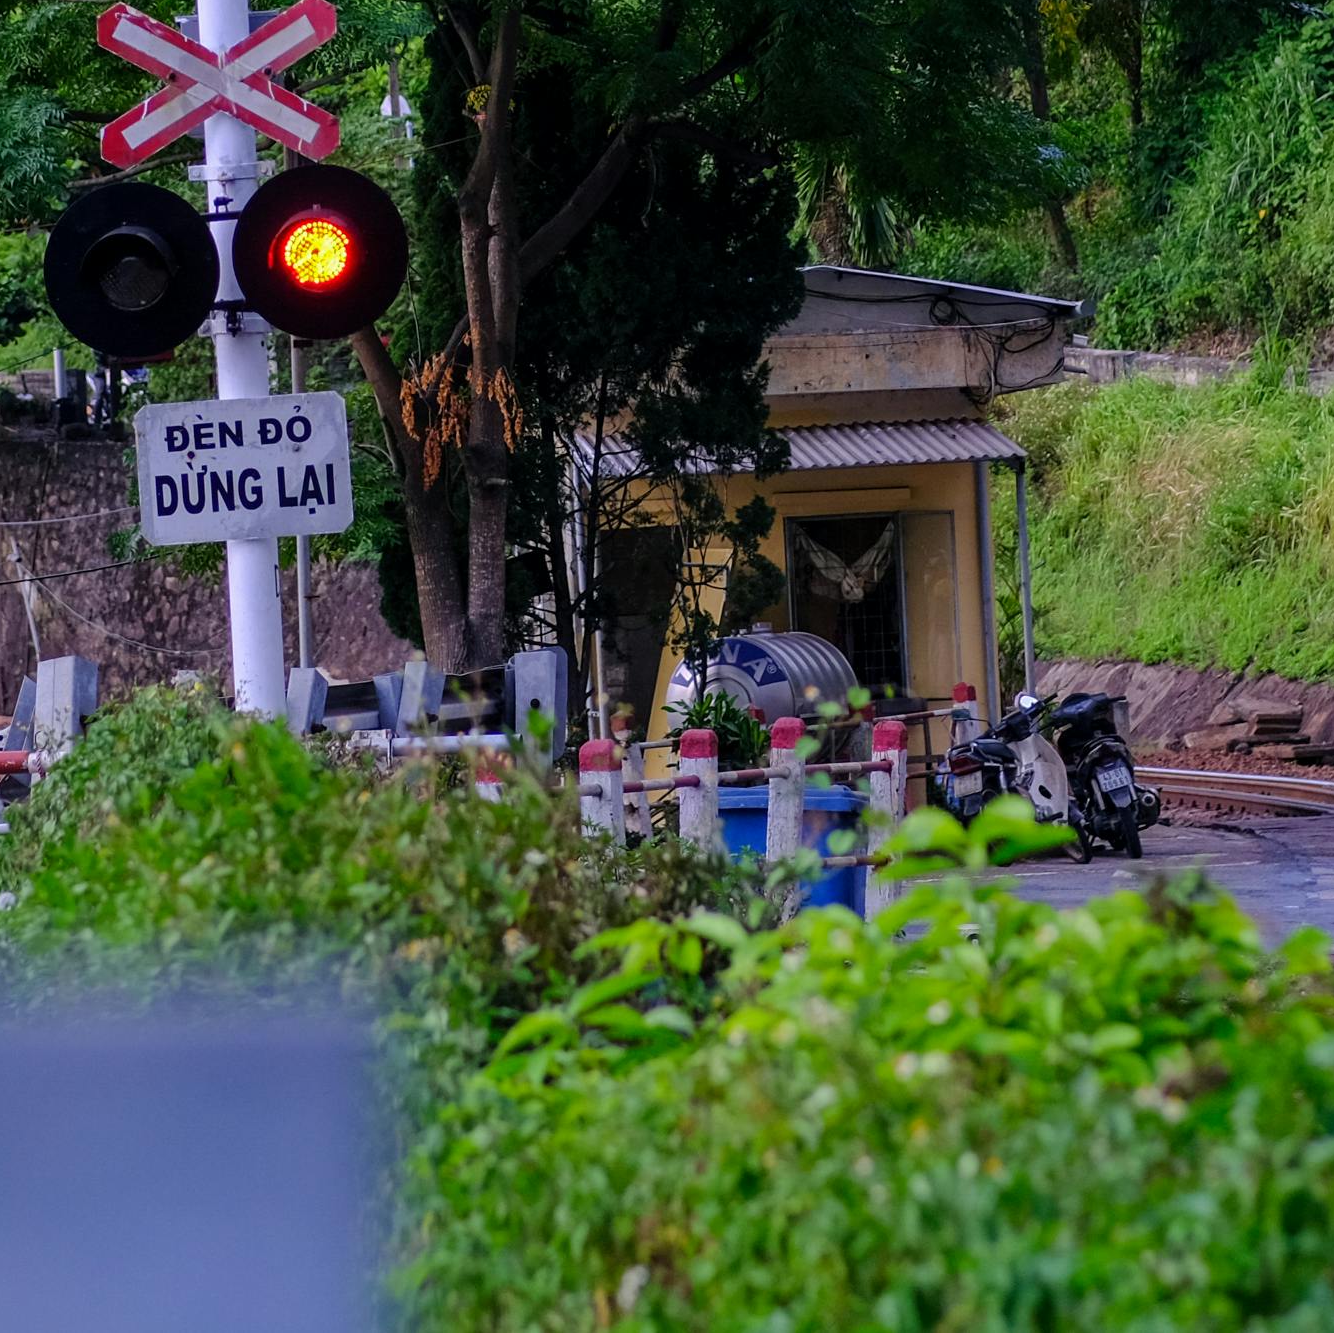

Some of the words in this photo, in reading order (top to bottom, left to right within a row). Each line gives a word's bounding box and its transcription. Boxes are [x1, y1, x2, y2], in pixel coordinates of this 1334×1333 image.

[164, 414, 244, 453] ĐÈN
[257, 405, 312, 446] ĐỎ
[154, 462, 264, 517] DỪNG
[277, 463, 336, 515] LẠI
